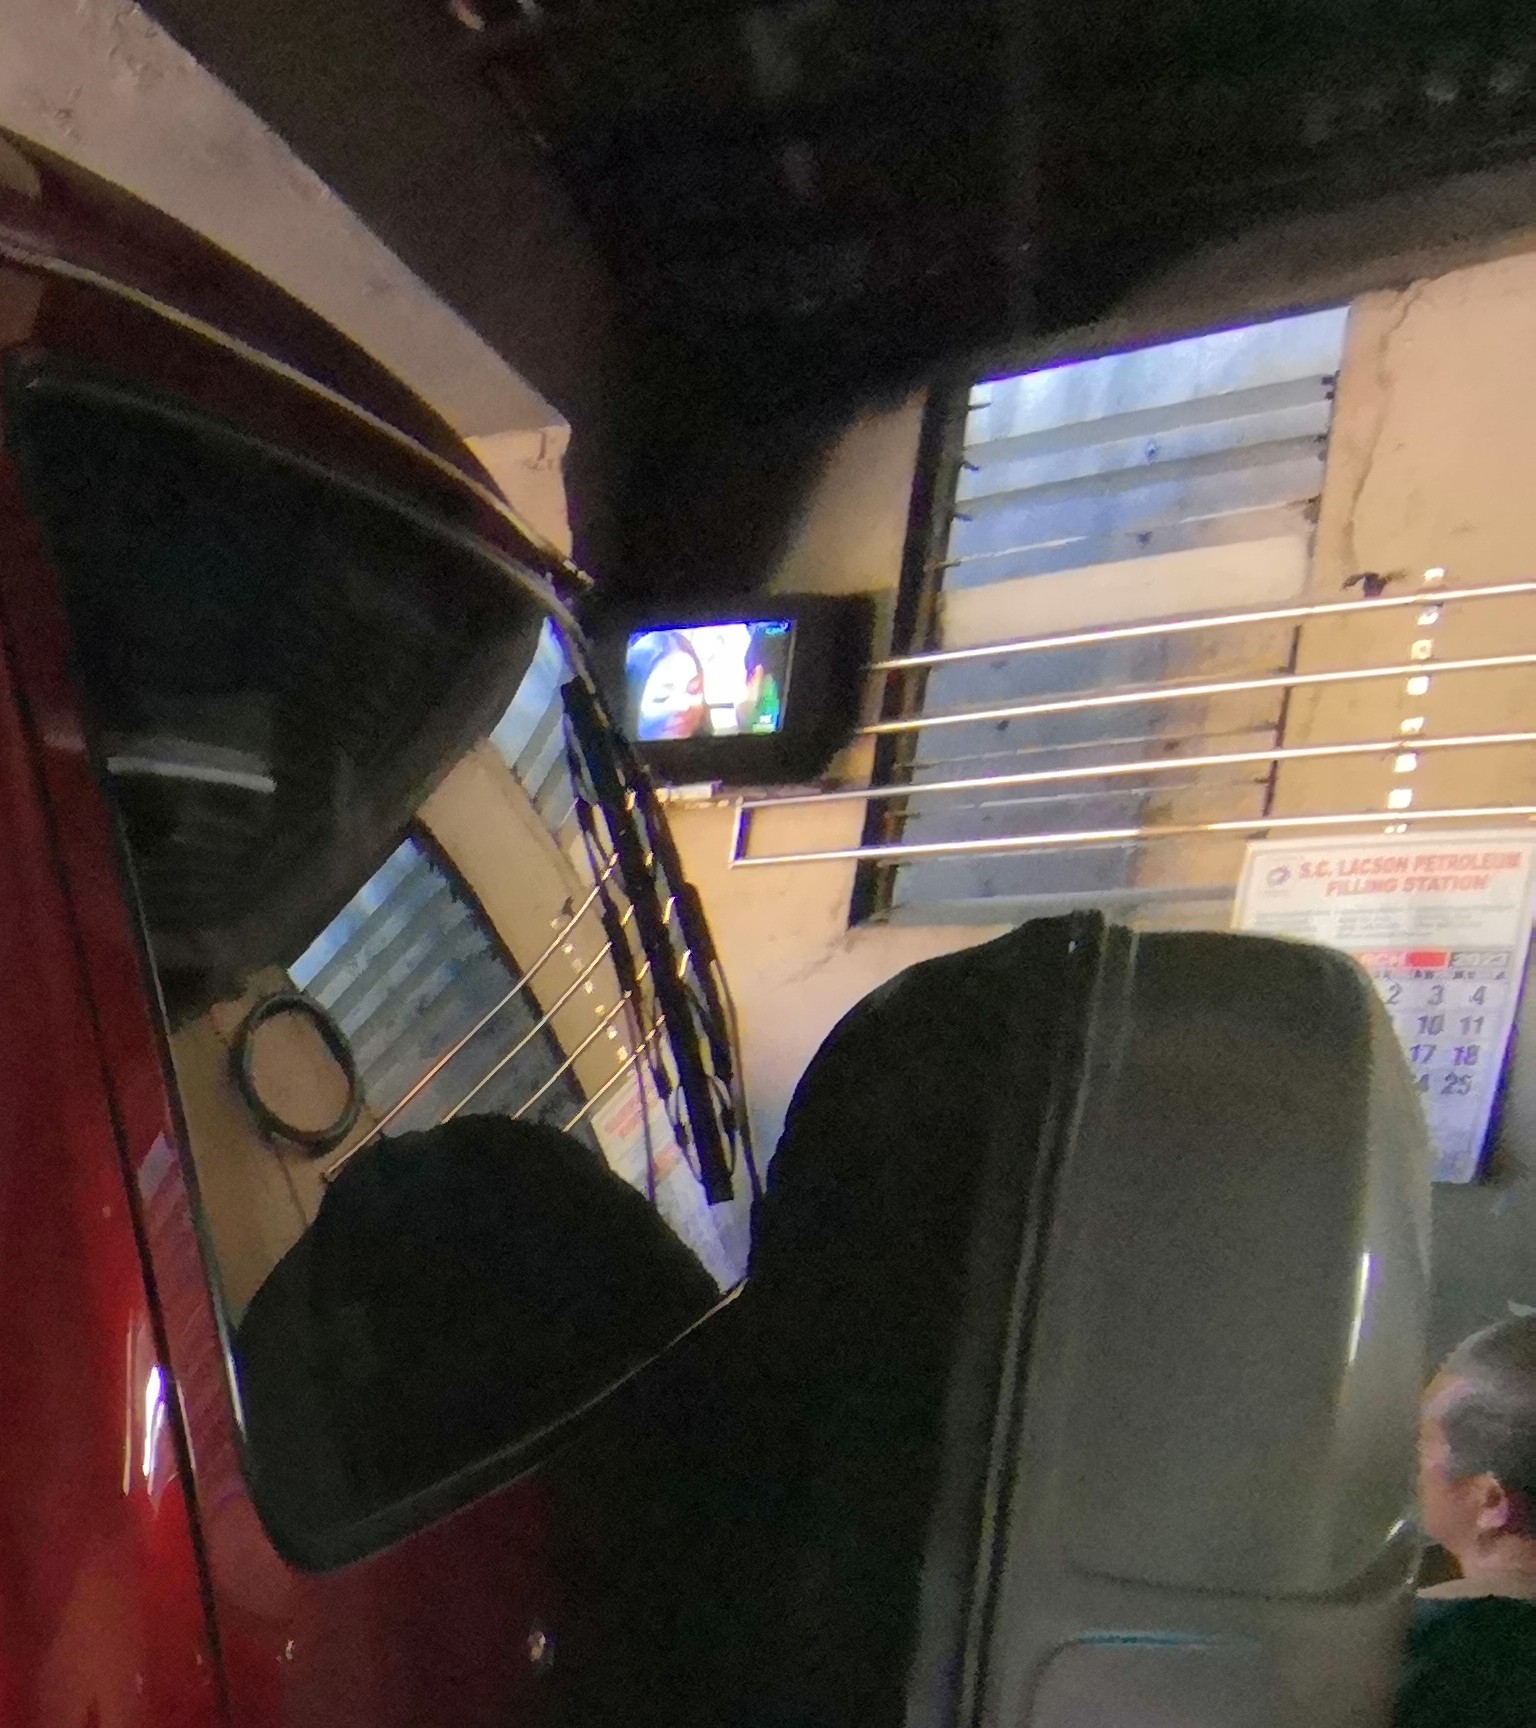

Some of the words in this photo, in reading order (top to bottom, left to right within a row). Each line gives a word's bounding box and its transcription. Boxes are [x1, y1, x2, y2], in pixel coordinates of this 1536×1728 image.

[1413, 852, 1522, 872] PETROLEUM
[1325, 879, 1397, 897] FILLING
[1402, 874, 1489, 893] STATION
[1385, 983, 1403, 1006] 2
[1427, 984, 1446, 1008] 3
[1469, 985, 1488, 1007] 4
[1417, 1013, 1445, 1036] 10
[1459, 1015, 1486, 1036] 11
[1409, 1044, 1437, 1065] 17
[1453, 1044, 1481, 1067] 18
[1440, 1072, 1472, 1096] 25
